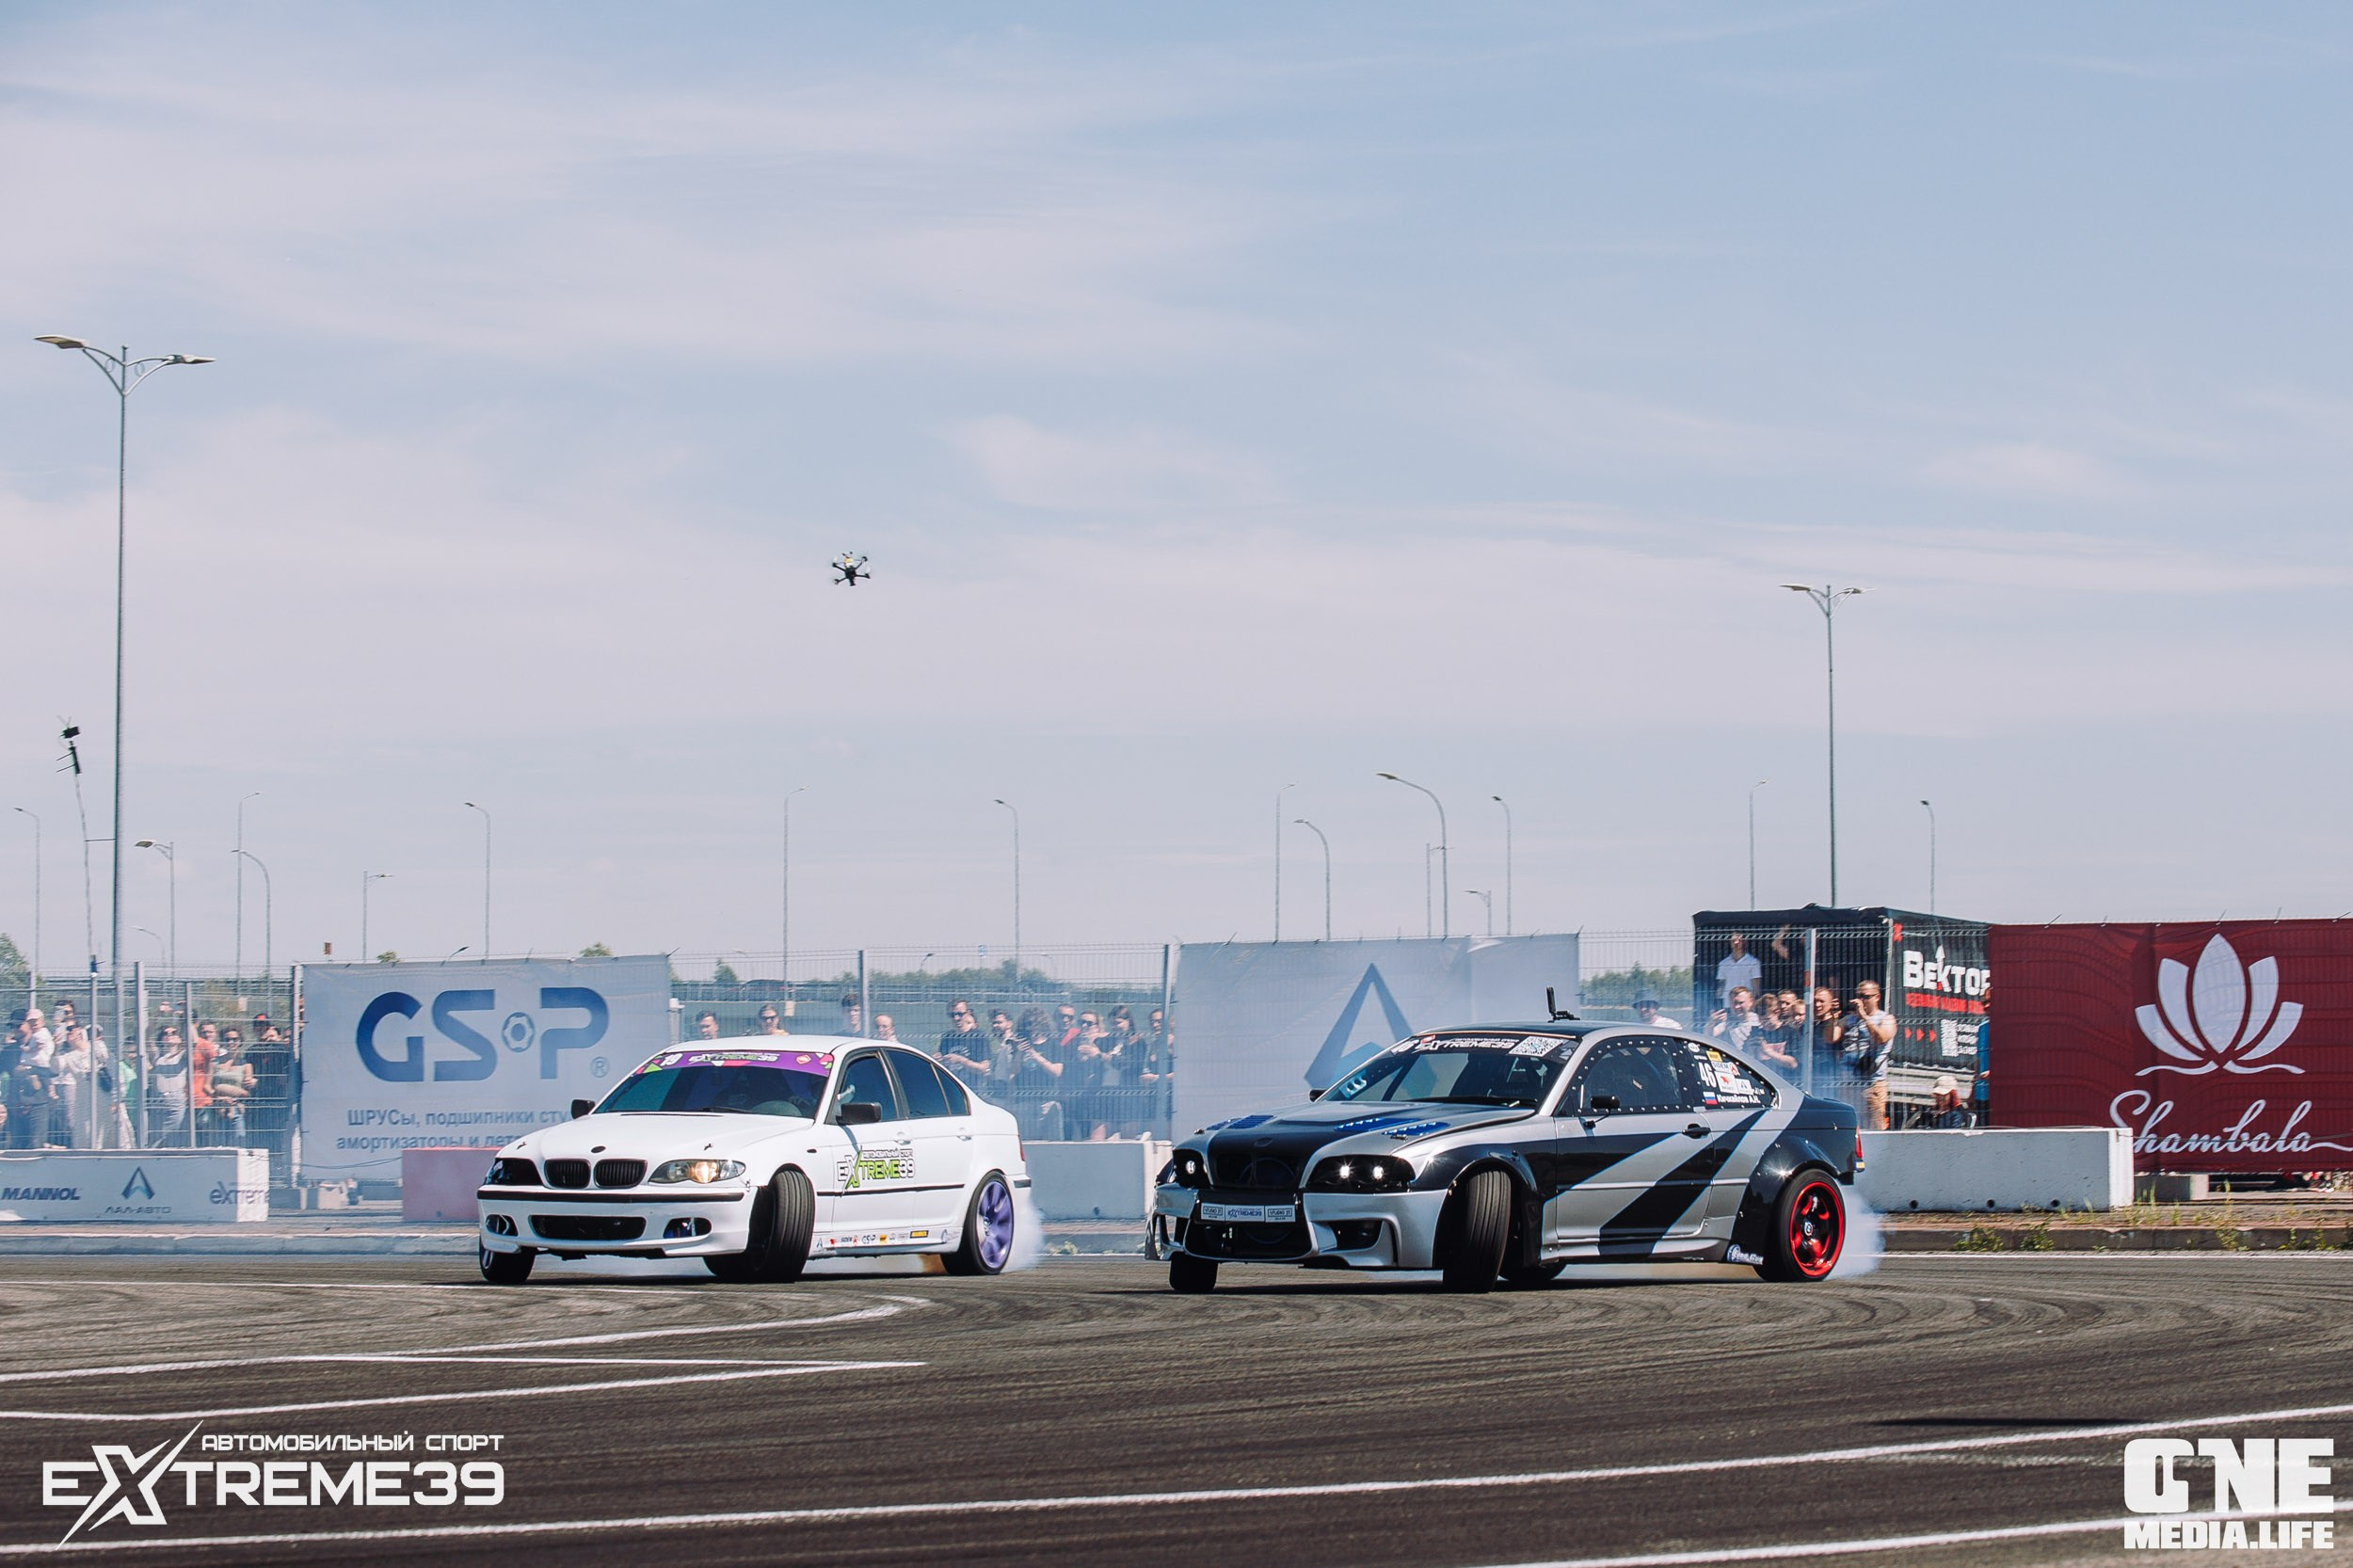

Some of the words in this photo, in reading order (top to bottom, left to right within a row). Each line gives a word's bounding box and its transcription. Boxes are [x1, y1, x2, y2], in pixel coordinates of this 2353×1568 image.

[1699, 1063, 1717, 1088] 46
[347, 1110, 420, 1128] ШРУСы,
[425, 1111, 535, 1128] подшипники
[539, 1111, 571, 1124] сту
[2109, 1090, 2353, 1153] Shambala
[837, 1145, 915, 1194] EXTREME39
[1, 1187, 81, 1200] MANNOL
